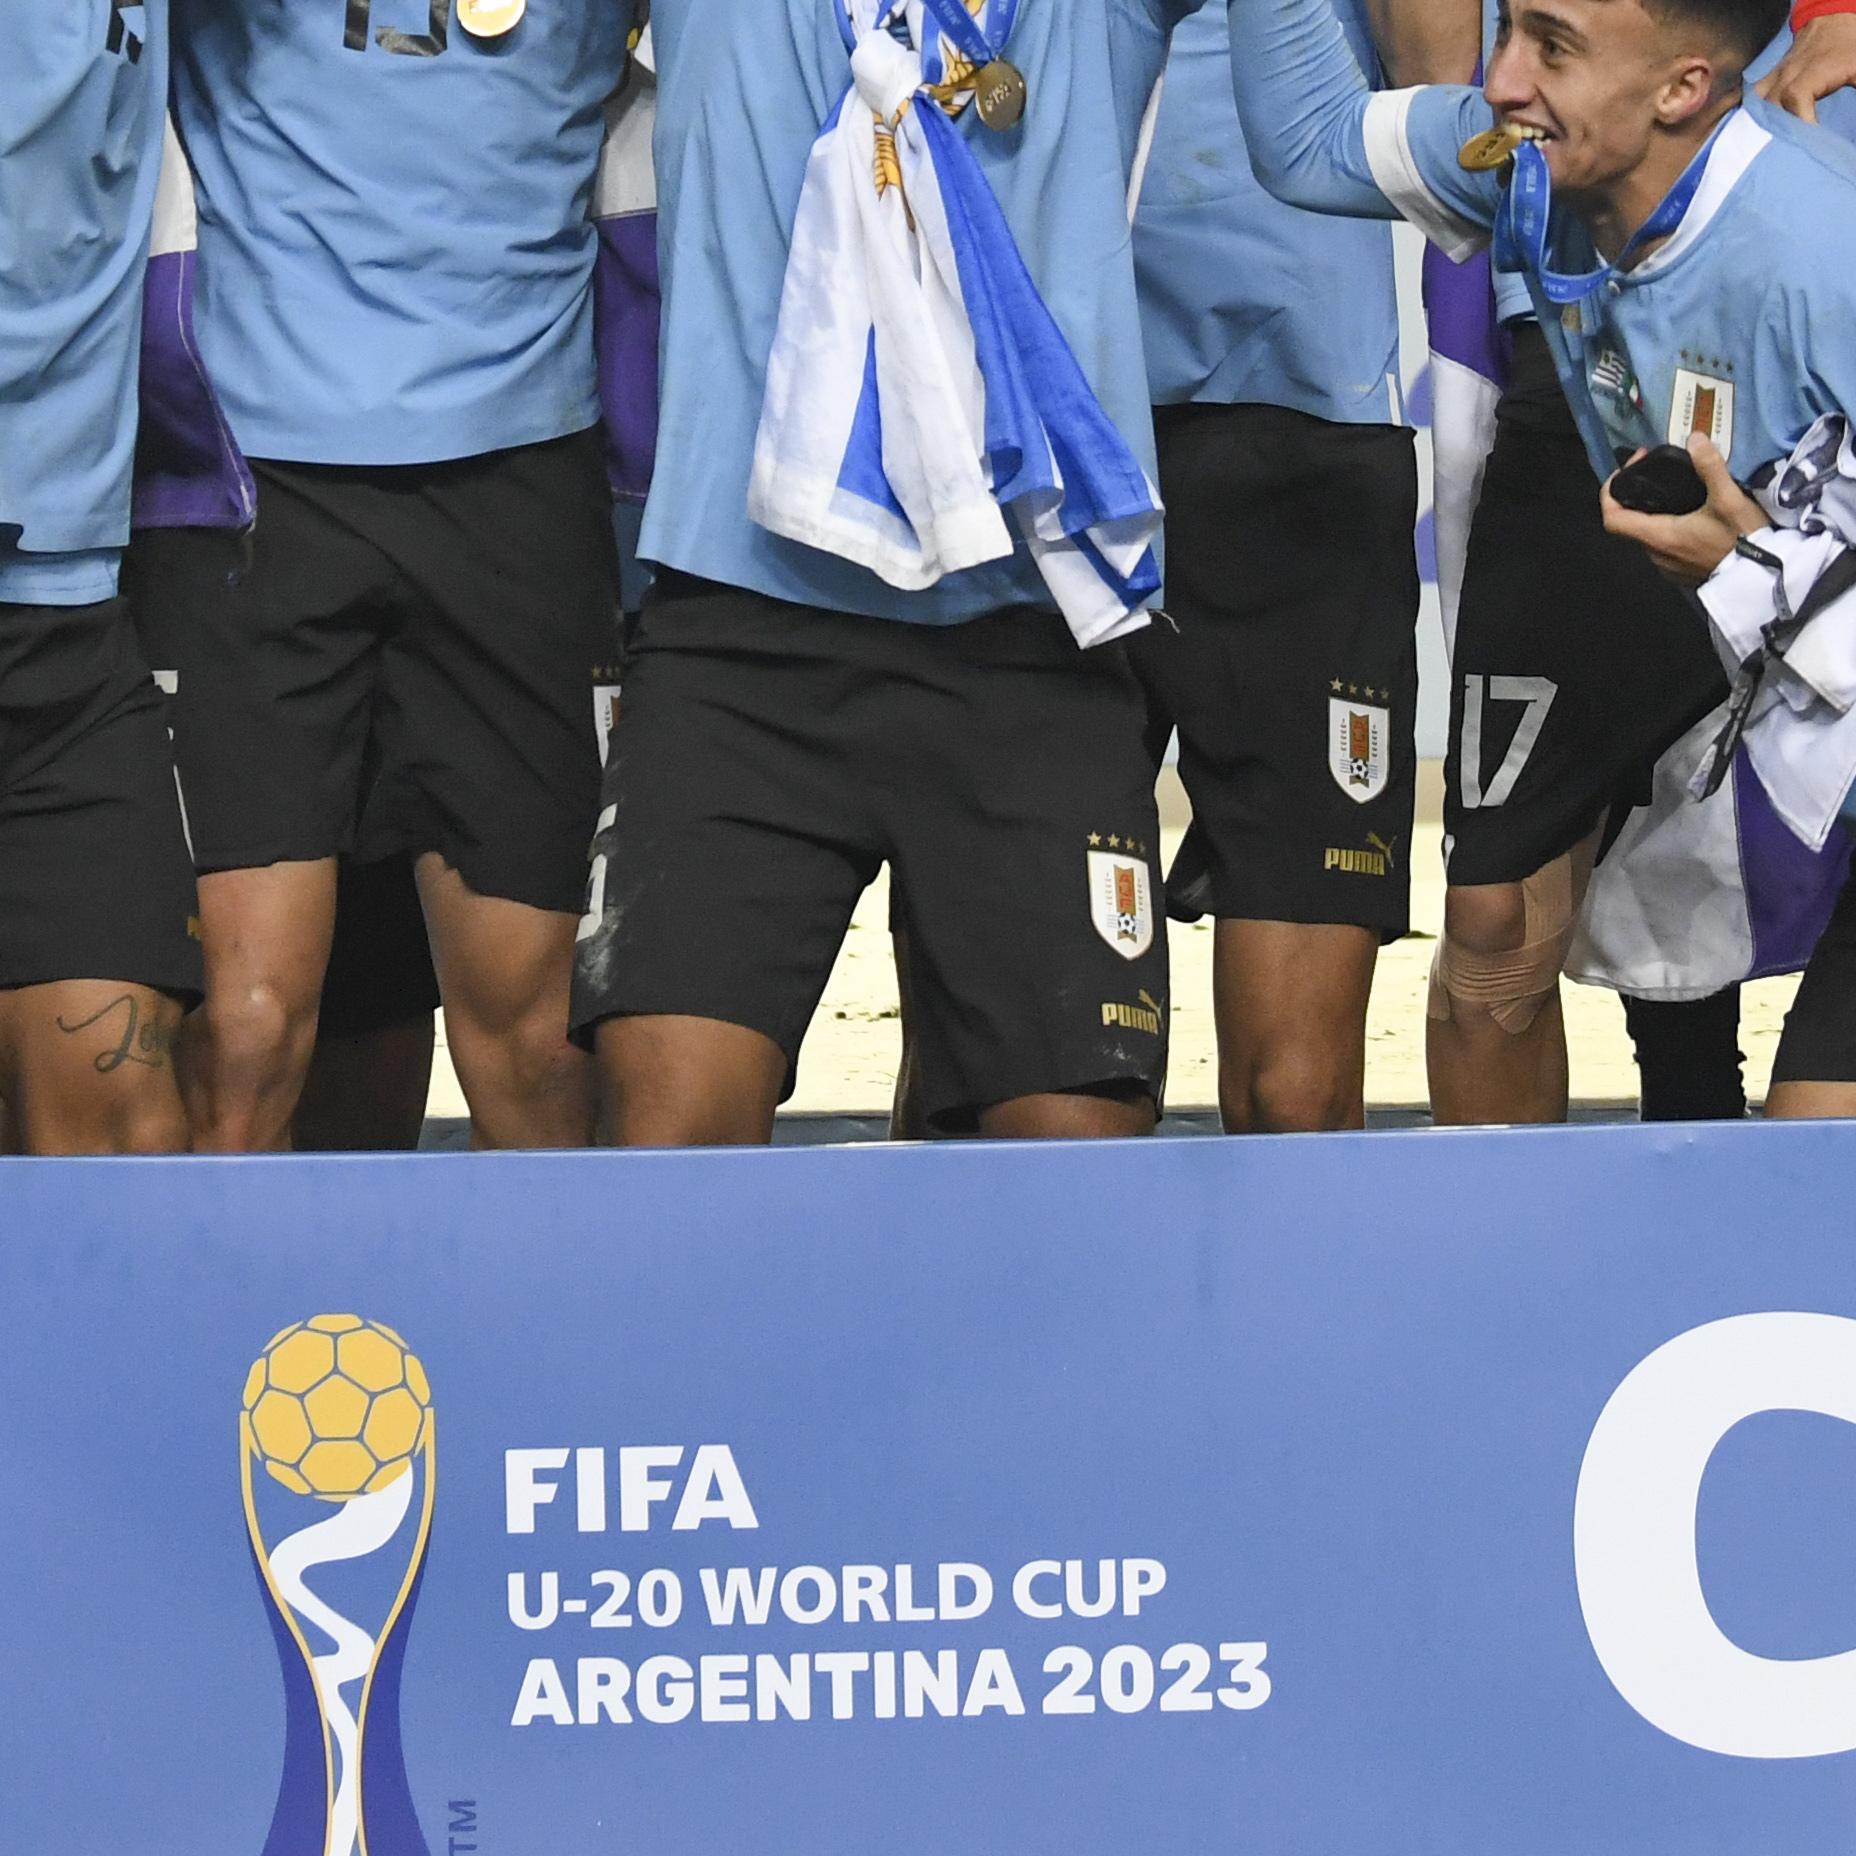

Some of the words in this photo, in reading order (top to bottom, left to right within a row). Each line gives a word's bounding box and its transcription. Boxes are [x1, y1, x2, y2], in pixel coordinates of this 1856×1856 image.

[1459, 673, 1559, 810] 17
[1324, 847, 1386, 876] PUMA
[1101, 1003, 1159, 1036] PUMA
[505, 1445, 759, 1534] FIFA
[508, 1569, 682, 1630] U-20
[700, 1560, 993, 1625] WORLD
[1012, 1558, 1167, 1619] CUP
[512, 1646, 1026, 1727] ARGENTINA
[1043, 1642, 1271, 1714] 2023
